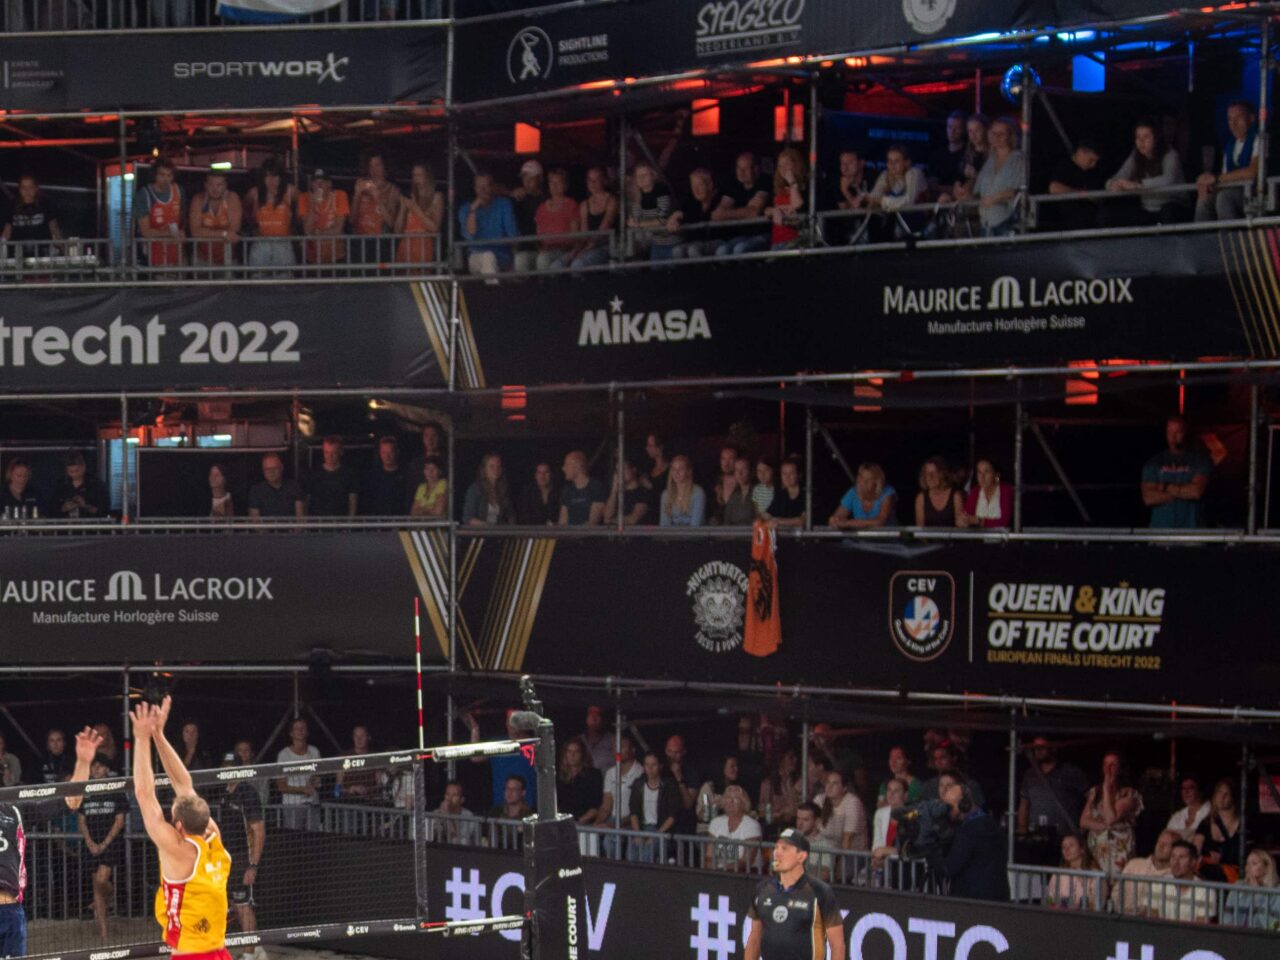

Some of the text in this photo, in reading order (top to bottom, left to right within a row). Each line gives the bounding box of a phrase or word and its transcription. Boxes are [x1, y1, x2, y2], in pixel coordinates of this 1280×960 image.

[696, 0, 805, 35] STAGECO
[558, 34, 609, 52] SIGHTLINE
[883, 278, 1134, 314] MAURICE LACROIX
[927, 314, 1086, 335] Manufacture Horlogère Suisse
[180, 320, 300, 363] 2022
[154, 573, 274, 600] LACROIX
[907, 578, 937, 592] CEV
[988, 582, 1166, 617] QUEEN & KING
[32, 609, 219, 625] Manufacture Horlogère Suisse
[988, 620, 1160, 651] OF THE COURT
[987, 650, 1160, 668] EUROPEAN FINALS UTRECHT 2022
[352, 759, 365, 767] CEV
[445, 867, 616, 951] #CV
[567, 895, 577, 946] COURT
[355, 925, 369, 934] CEV
